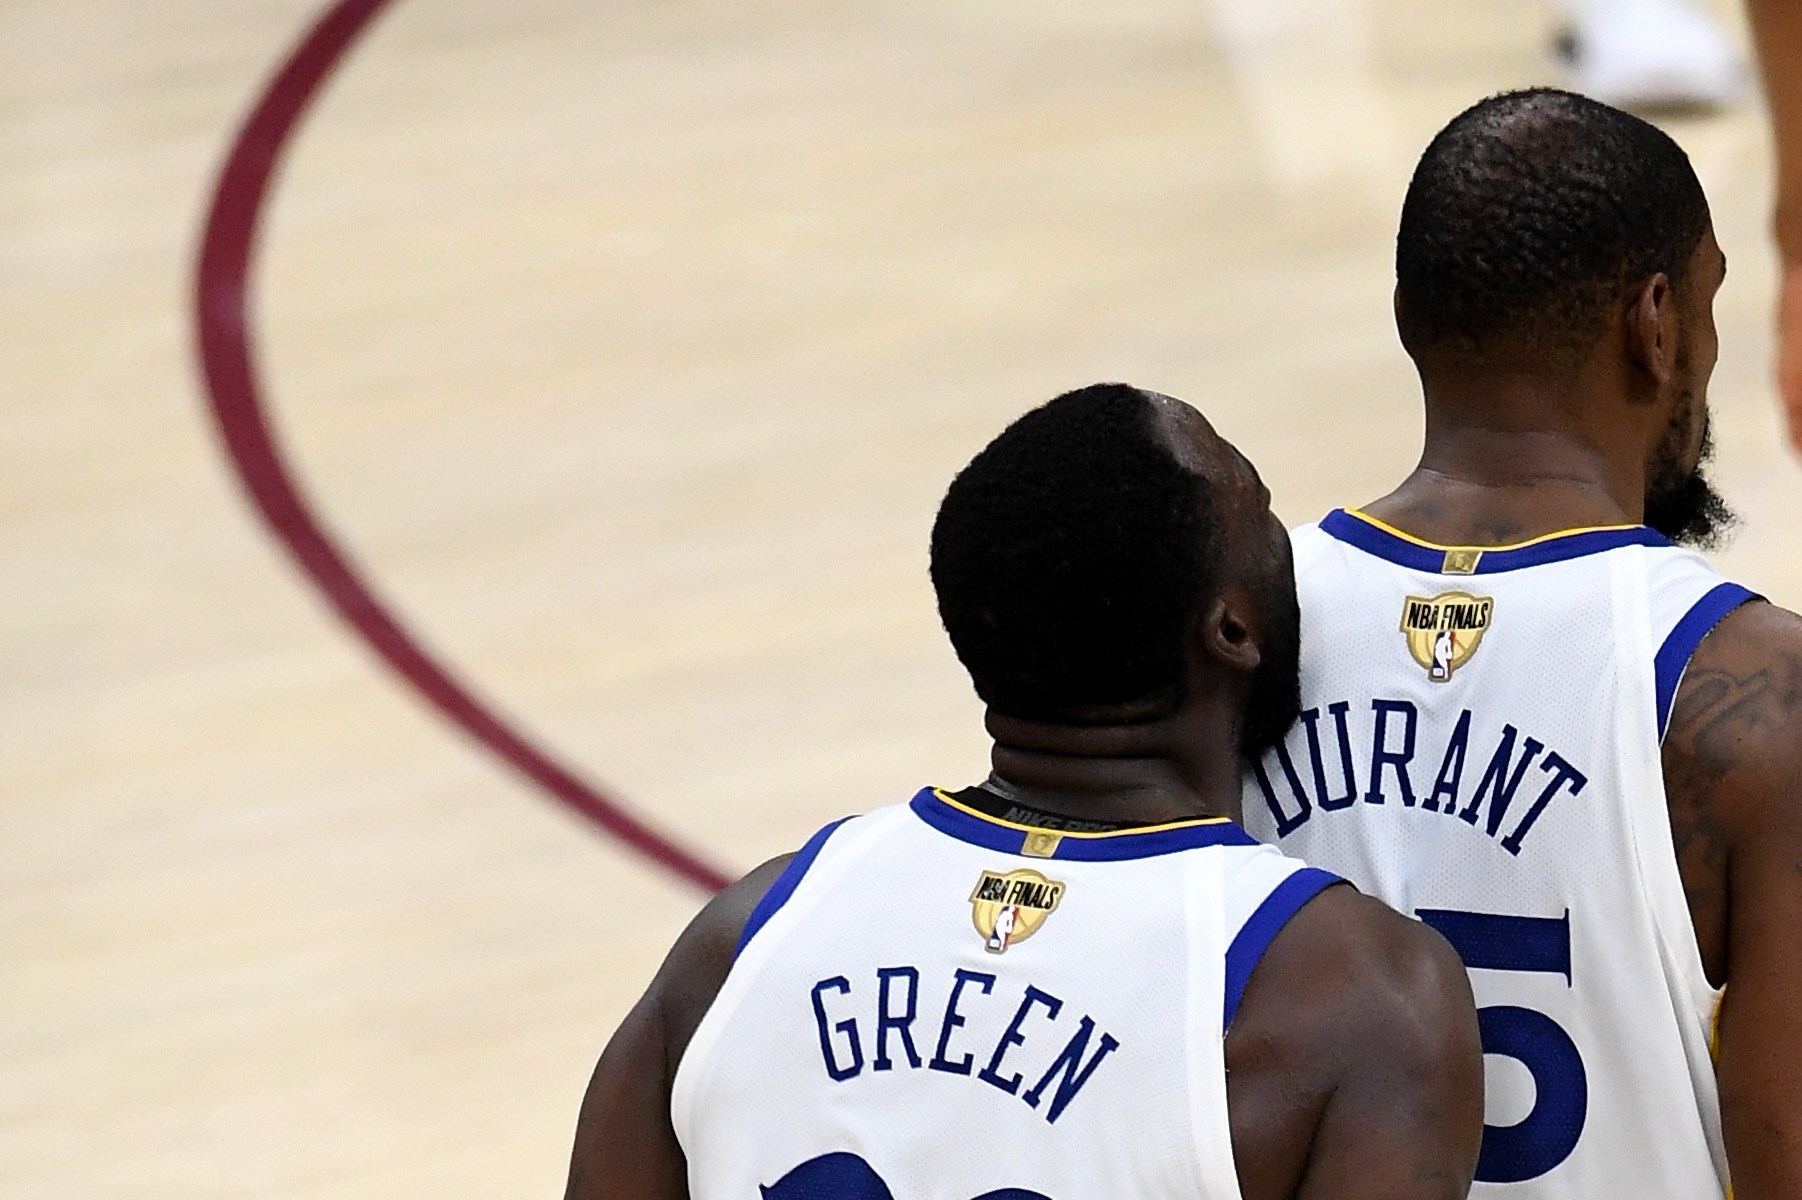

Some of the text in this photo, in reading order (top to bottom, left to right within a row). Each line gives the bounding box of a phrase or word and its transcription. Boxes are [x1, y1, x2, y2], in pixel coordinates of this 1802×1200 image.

[1407, 602, 1488, 630] NBA FINALS
[1252, 699, 1588, 857] DURANT
[976, 876, 1060, 910] NBA FINALS
[811, 966, 1119, 1125] GREEN
